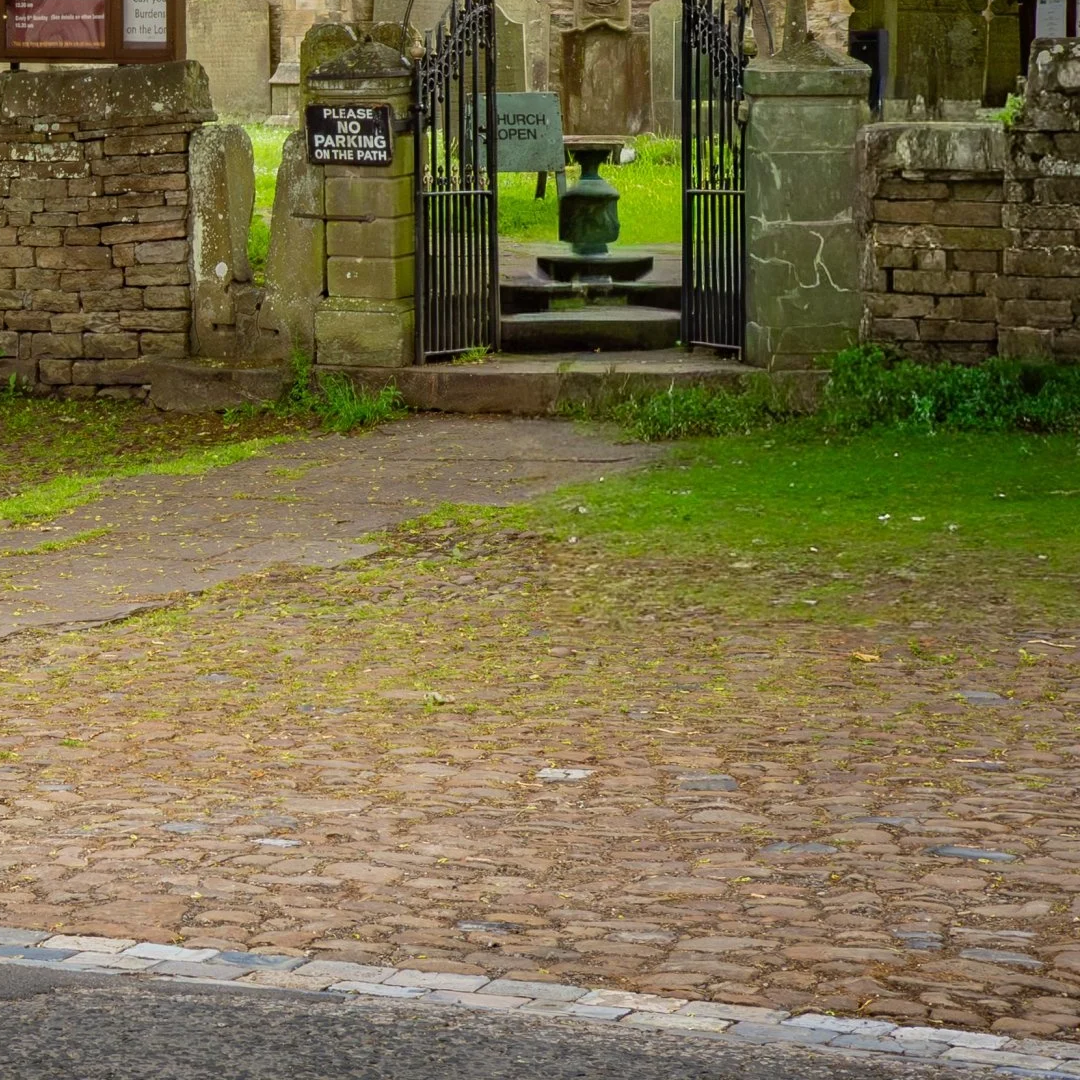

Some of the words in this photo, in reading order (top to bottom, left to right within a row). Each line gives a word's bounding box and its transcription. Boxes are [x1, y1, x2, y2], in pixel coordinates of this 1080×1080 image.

[126, 26, 137, 34] on
[139, 24, 152, 34] the
[323, 108, 374, 119] PLEASE
[497, 113, 546, 126] HURCH
[337, 120, 361, 134] NO
[497, 128, 537, 140] OPEN
[314, 134, 387, 149] PARKING
[314, 149, 331, 160] ON
[332, 149, 354, 160] THE
[357, 150, 387, 161] PATH
